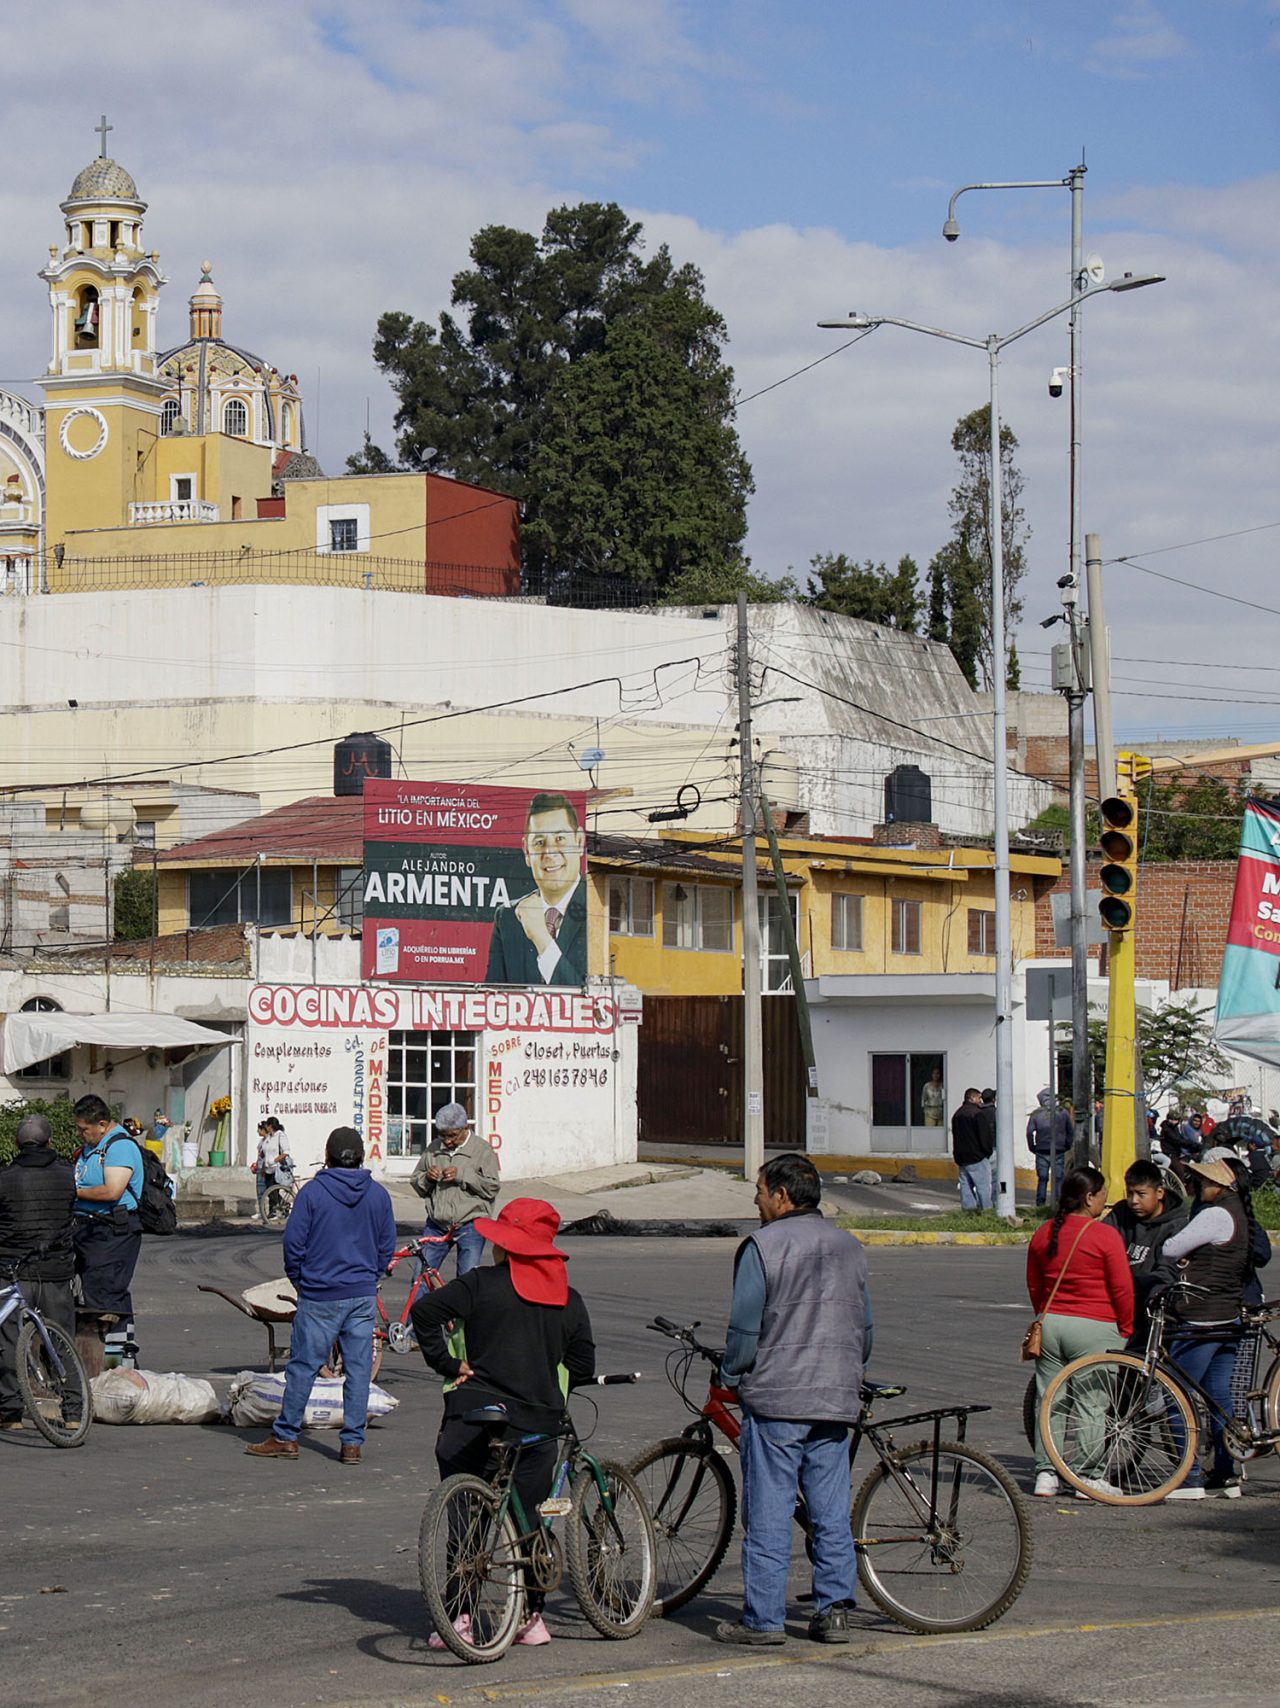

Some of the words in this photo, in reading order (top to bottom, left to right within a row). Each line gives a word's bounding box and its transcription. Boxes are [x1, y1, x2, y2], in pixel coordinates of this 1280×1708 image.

[410, 795, 465, 808] IMPORTANCIA
[467, 798, 480, 808] DEL
[378, 808, 412, 825] LITIO
[416, 810, 433, 826] EN
[401, 859, 475, 874] ALEJANDRO
[363, 871, 512, 908] ARMENTA
[403, 944, 438, 955] ADQUIÉRELO
[439, 946, 447, 954] EN
[448, 946, 477, 955] LIBRERÍAS
[429, 956, 464, 964] PORRUA.MX
[249, 985, 399, 1029] COCINAS
[412, 991, 618, 1034] INTEGRALES
[254, 1042, 332, 1062] Complementos
[371, 1036, 386, 1053] DE
[491, 1036, 521, 1057] SOBRE
[524, 1041, 564, 1061] Closet
[573, 1041, 610, 1060] Puertas
[253, 1078, 328, 1101] Reparaciones
[506, 1076, 520, 1096] Cel
[260, 1104, 270, 1114] DE
[368, 1059, 383, 1159] MADERA
